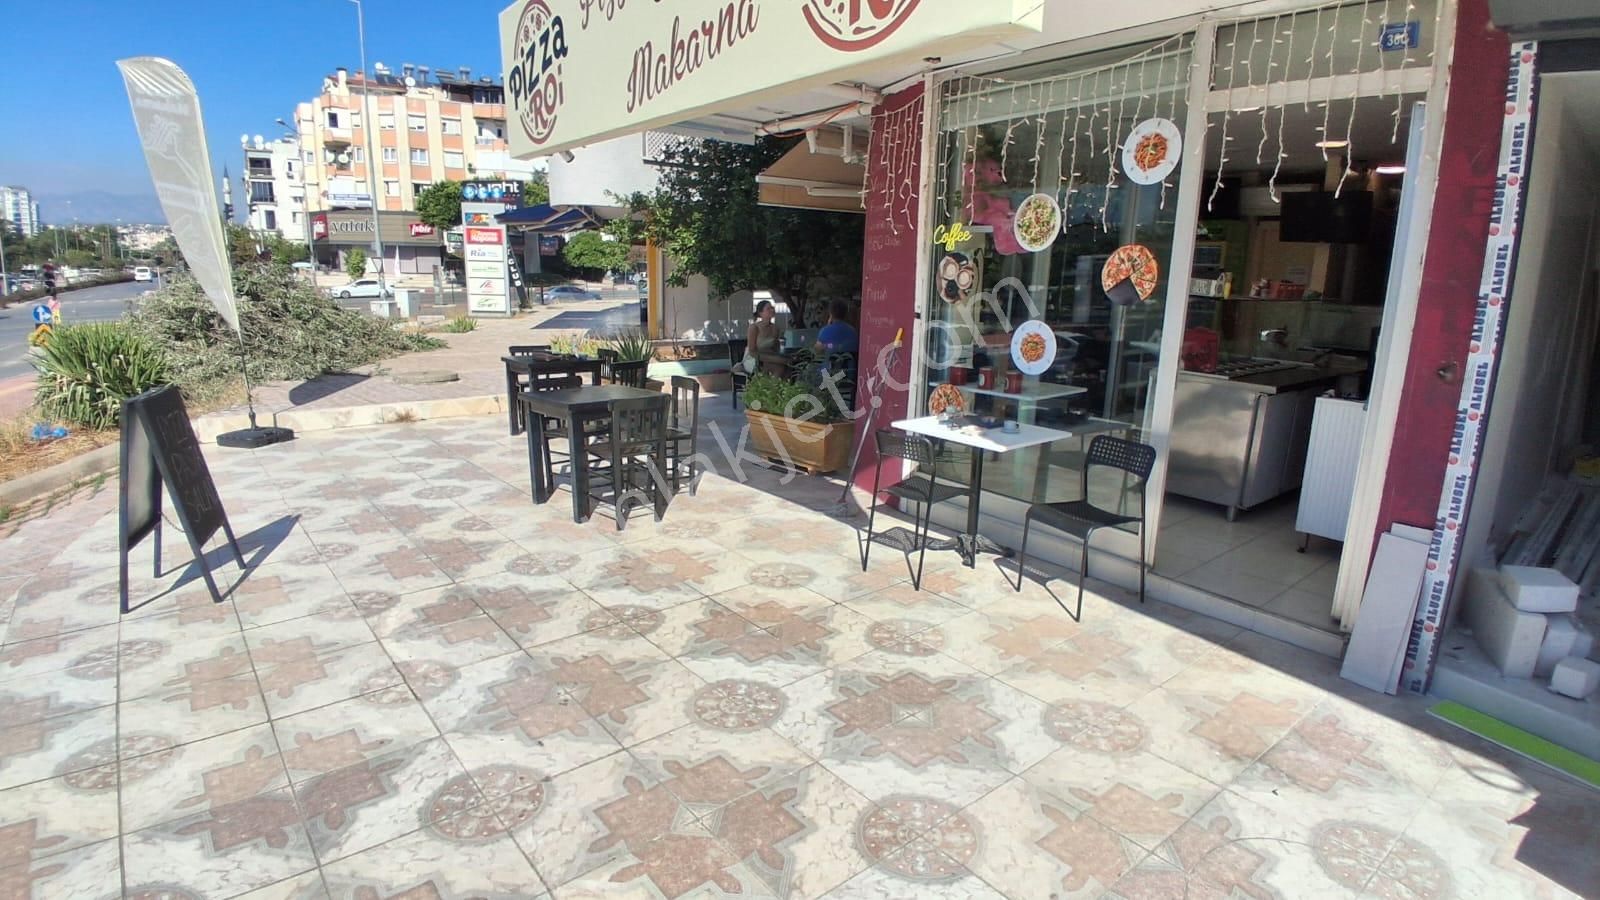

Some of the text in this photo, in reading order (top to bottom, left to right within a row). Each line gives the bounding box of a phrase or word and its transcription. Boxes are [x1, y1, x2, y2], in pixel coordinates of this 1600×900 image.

[626, 0, 760, 114] Makarna
[1508, 122, 1526, 174] ALUSEL
[933, 221, 973, 251] Coffee
[1491, 244, 1509, 295] ALUSEL
[1471, 293, 1489, 343] ALUSEL
[1470, 362, 1489, 411] ALUSEL
[1450, 408, 1468, 455] ALUSEL
[1448, 474, 1467, 521] ALUSEL
[1428, 517, 1447, 561] ALUSEL
[1426, 580, 1444, 624] ALUSEL
[1406, 618, 1425, 661] ALUSEL
